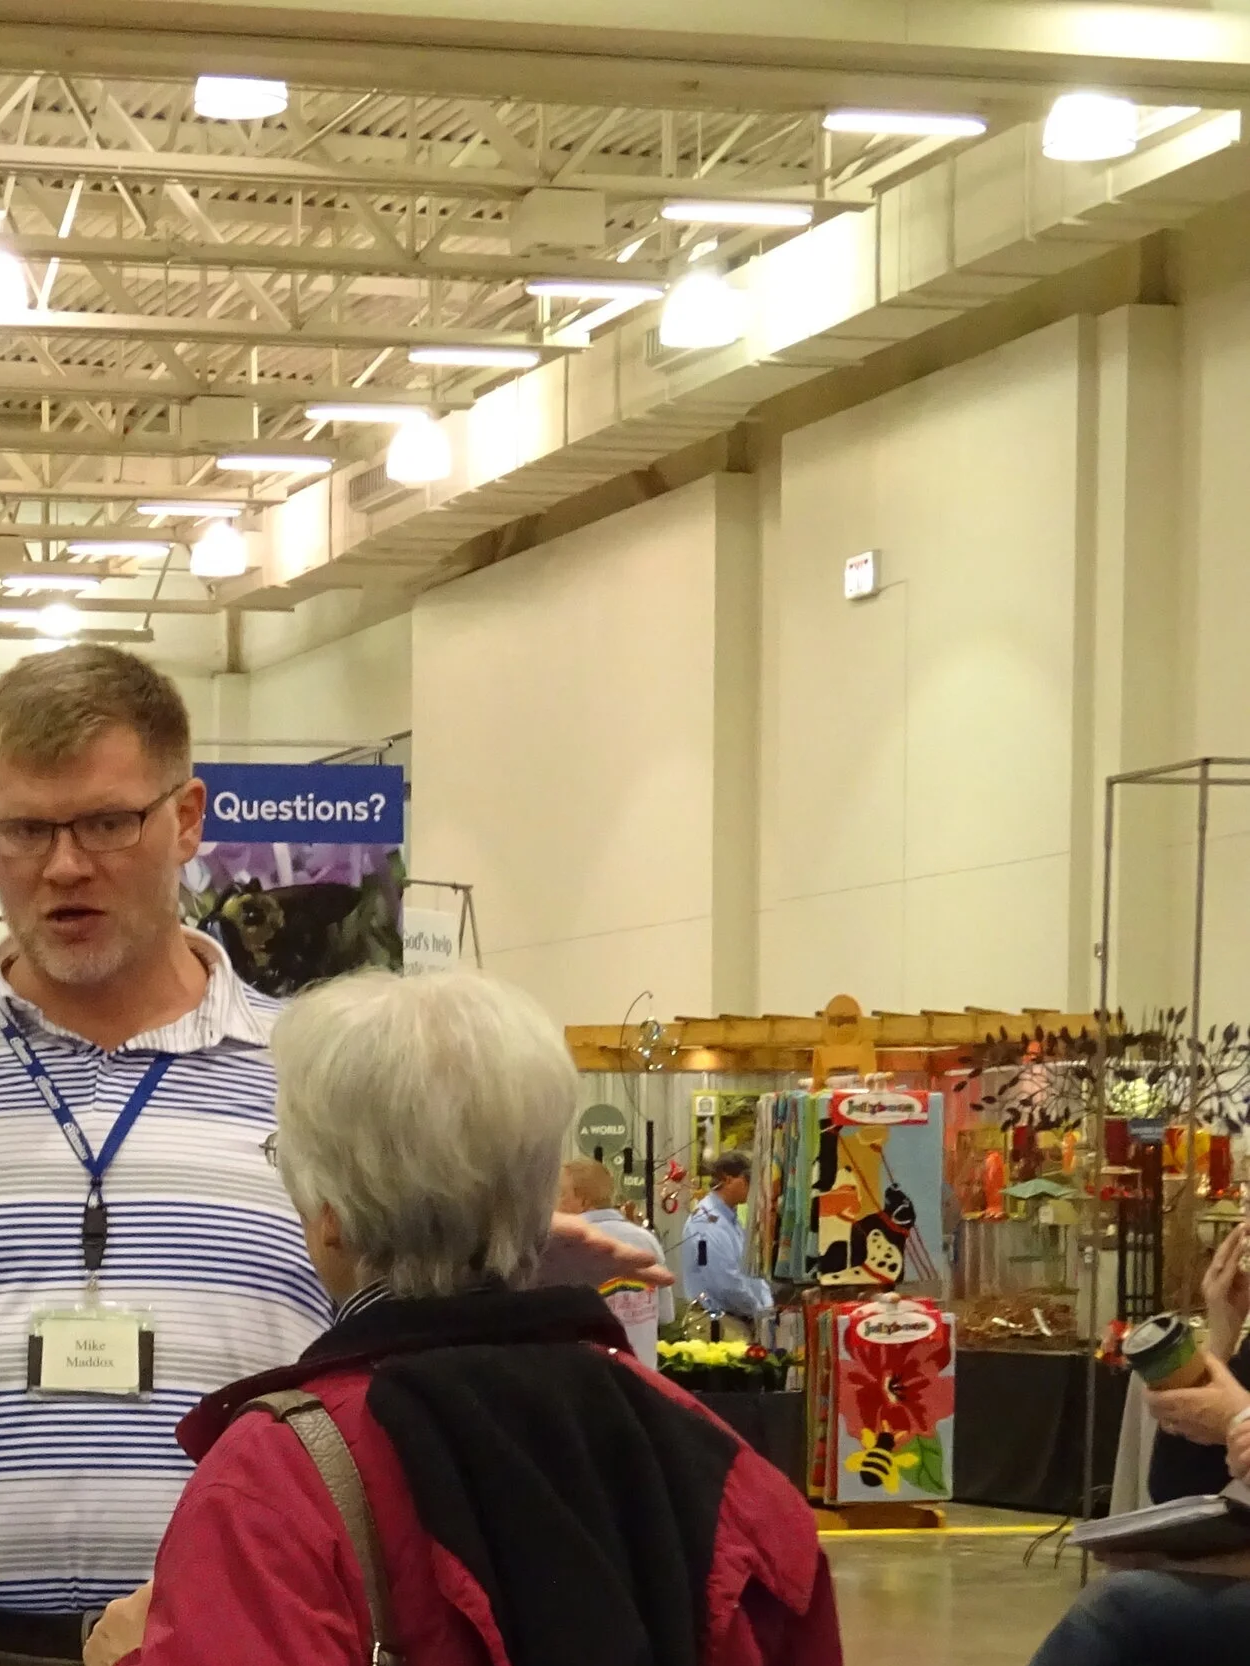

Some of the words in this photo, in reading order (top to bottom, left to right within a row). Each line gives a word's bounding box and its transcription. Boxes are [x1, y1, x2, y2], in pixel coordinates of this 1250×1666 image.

[213, 791, 387, 823] Questions?
[431, 933, 453, 957] help
[580, 1126, 588, 1135] A
[589, 1125, 626, 1135] WORLD
[623, 1176, 646, 1186] IDEA
[75, 1339, 106, 1351] Mike
[66, 1356, 115, 1368] Maddox
